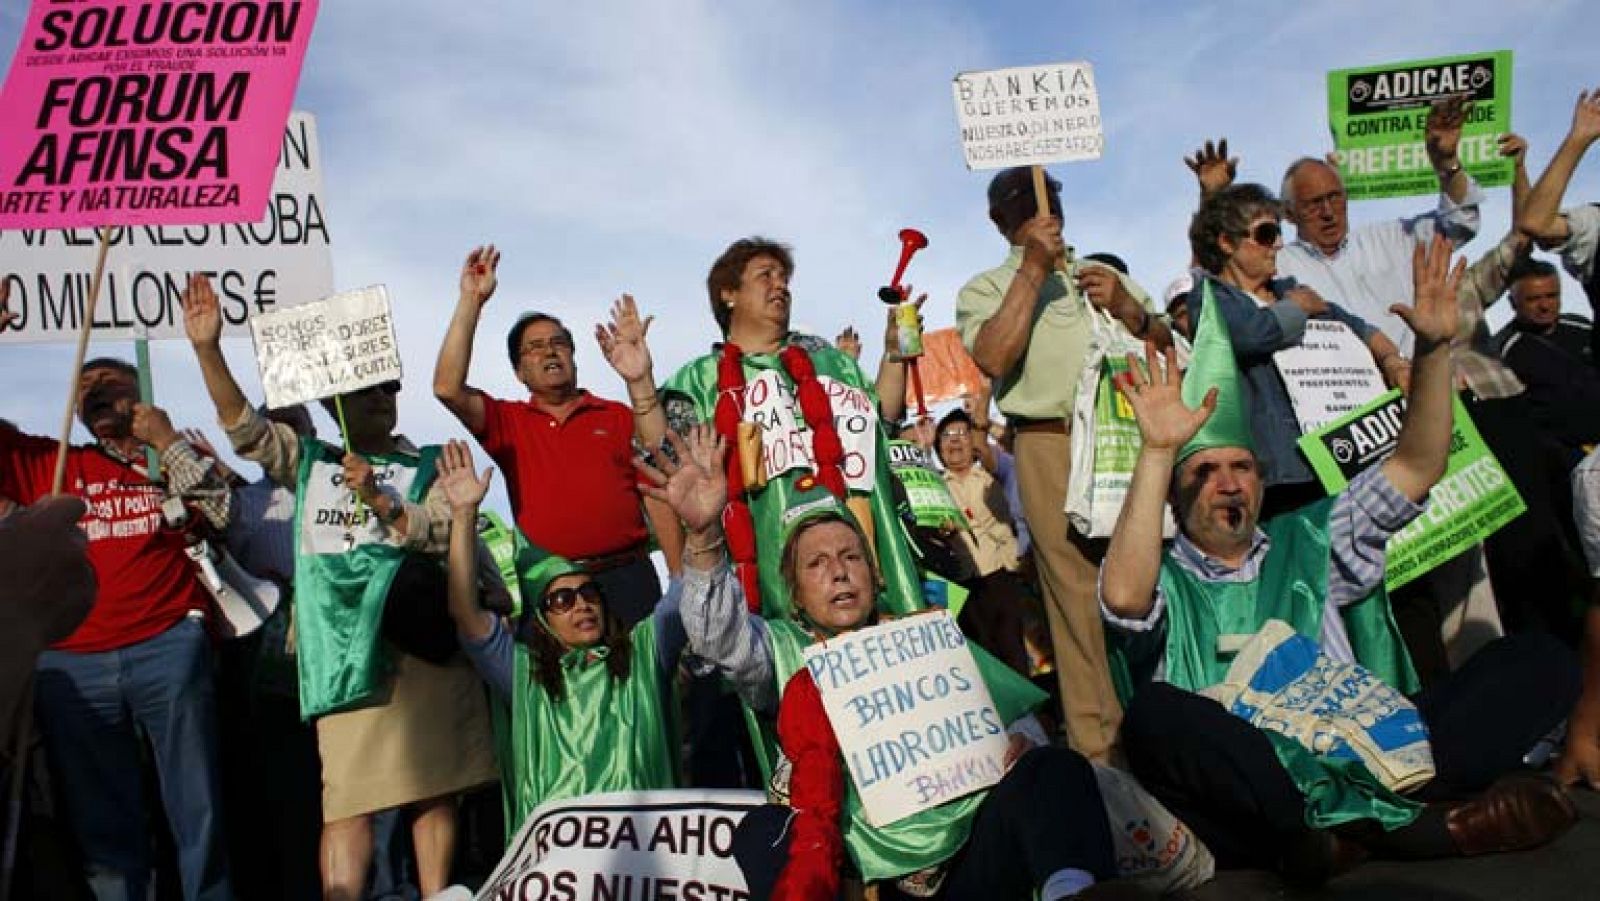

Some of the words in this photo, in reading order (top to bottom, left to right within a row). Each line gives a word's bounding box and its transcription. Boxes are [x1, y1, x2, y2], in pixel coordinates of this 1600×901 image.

[35, 1, 300, 51] SOLUCION
[36, 72, 251, 130] FORUM
[1373, 63, 1470, 100] ADICAE
[964, 95, 1089, 116] QUEREMOS
[1347, 116, 1411, 137] CONTRA
[14, 126, 229, 186] AFINSA
[0, 190, 54, 214] ARTE
[59, 189, 76, 211] Y
[77, 184, 241, 211] NATURALEZA
[844, 667, 971, 727] BANCOS
[852, 707, 1001, 788] LADRONES
[535, 815, 642, 854] ROBA
[647, 815, 737, 859] AHO
